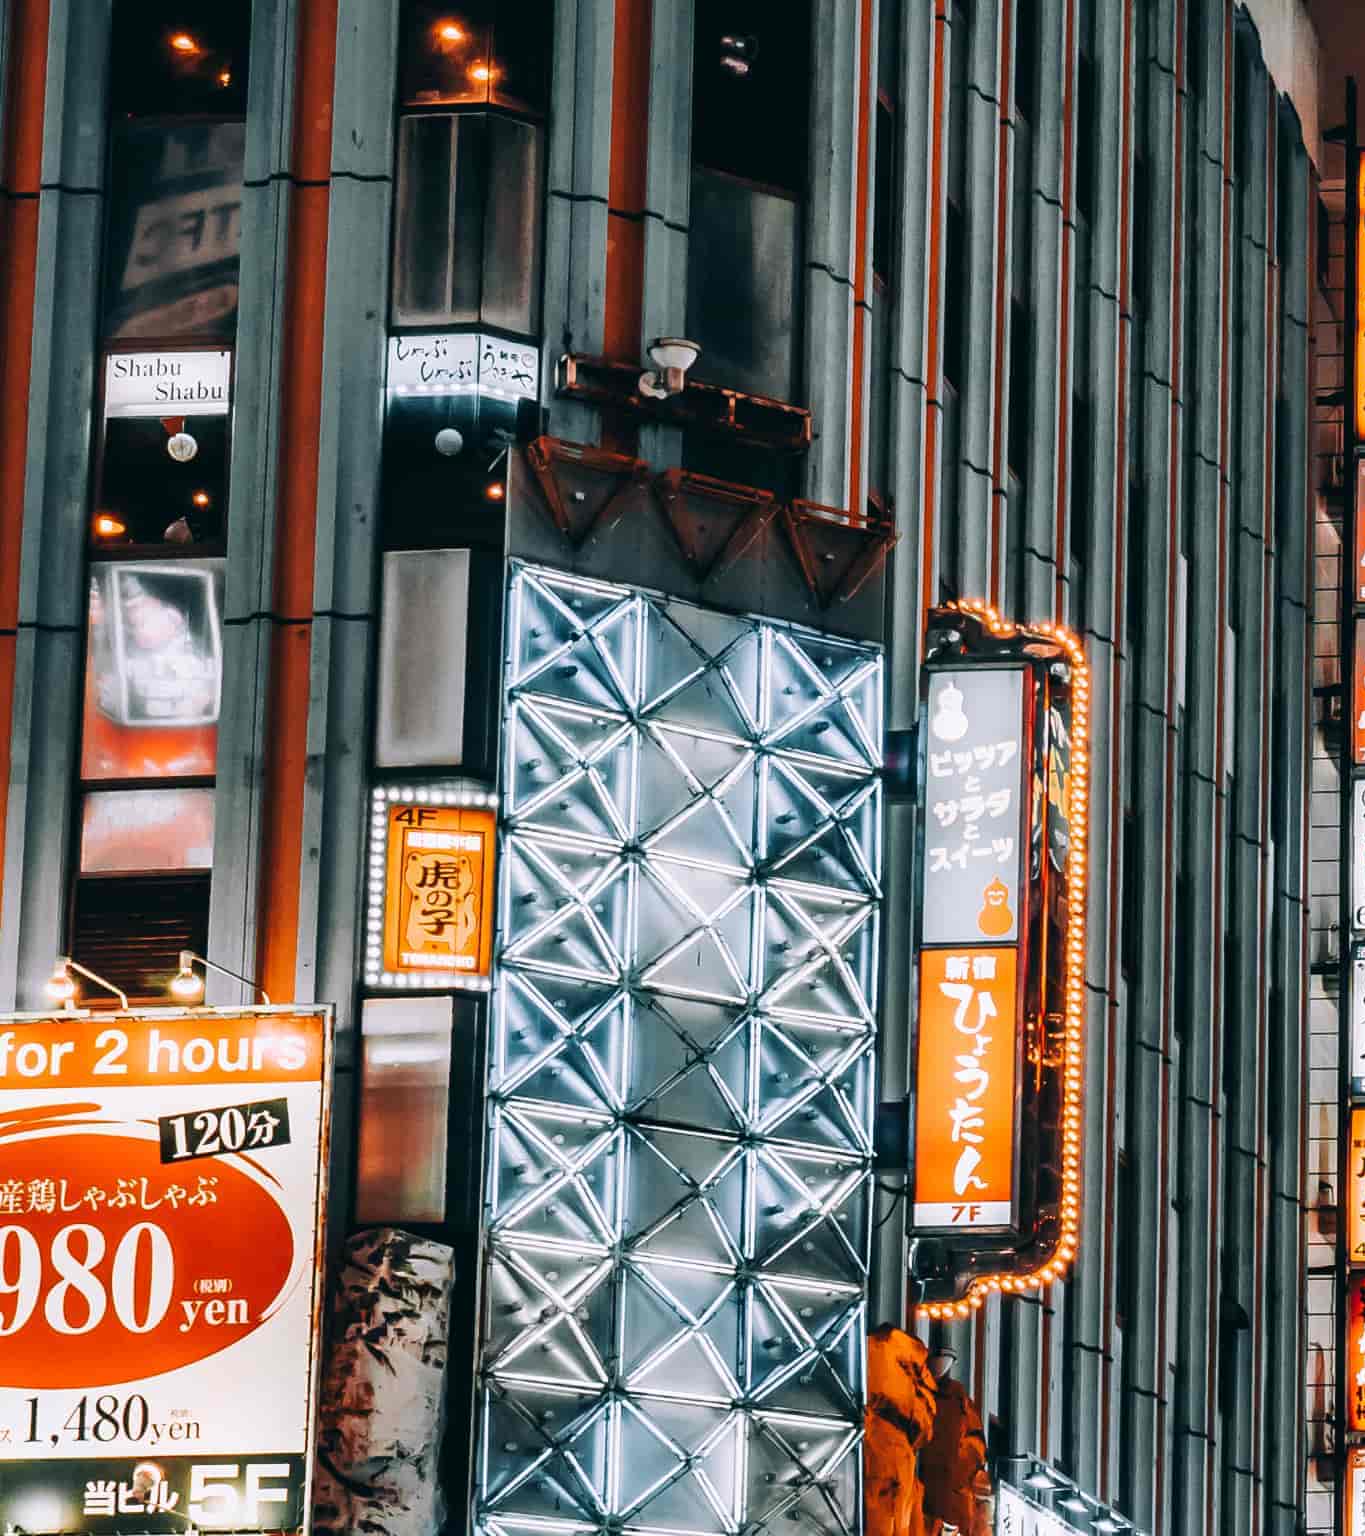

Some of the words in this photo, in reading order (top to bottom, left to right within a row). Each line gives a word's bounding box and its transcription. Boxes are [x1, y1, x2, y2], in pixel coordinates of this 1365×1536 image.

[114, 359, 182, 378] Shabu
[154, 380, 224, 401] Shabu
[396, 808, 438, 827] 4F
[933, 790, 1012, 828] サラダ
[928, 837, 1015, 873] スイーツ
[416, 859, 460, 936] 虎の子
[0, 1030, 75, 1076] for
[93, 1037, 128, 1074] 2
[148, 1031, 308, 1072] hours
[939, 981, 999, 1197] ひょうたん
[167, 1108, 281, 1160] 120分
[951, 1205, 982, 1223] 7F
[179, 1295, 249, 1333] yen
[189, 1463, 291, 1526] 5F
